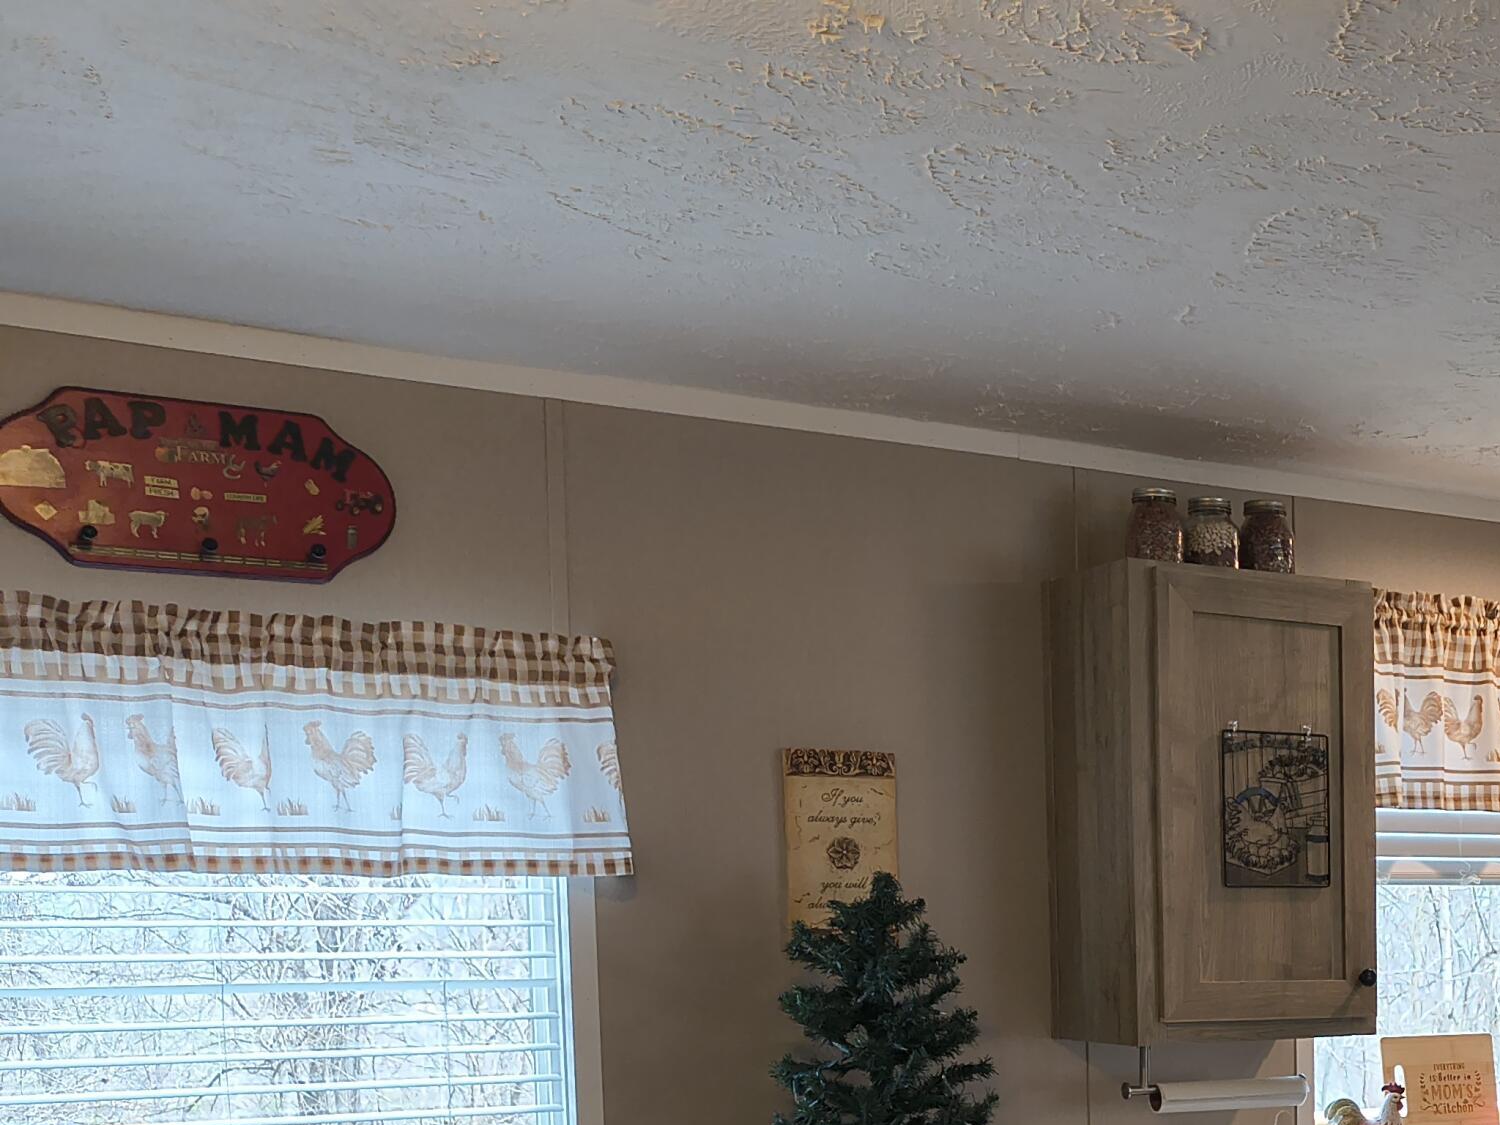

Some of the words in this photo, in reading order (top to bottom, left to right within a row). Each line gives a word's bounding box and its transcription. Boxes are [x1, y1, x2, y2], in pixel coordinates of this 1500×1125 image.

[37, 397, 167, 450] PAP
[218, 410, 356, 484] MAM
[821, 787, 845, 807] If
[843, 795, 864, 808] you
[807, 810, 848, 829] always
[820, 881, 843, 894] you
[844, 876, 869, 889] will
[1431, 1083, 1474, 1101] MOM'S
